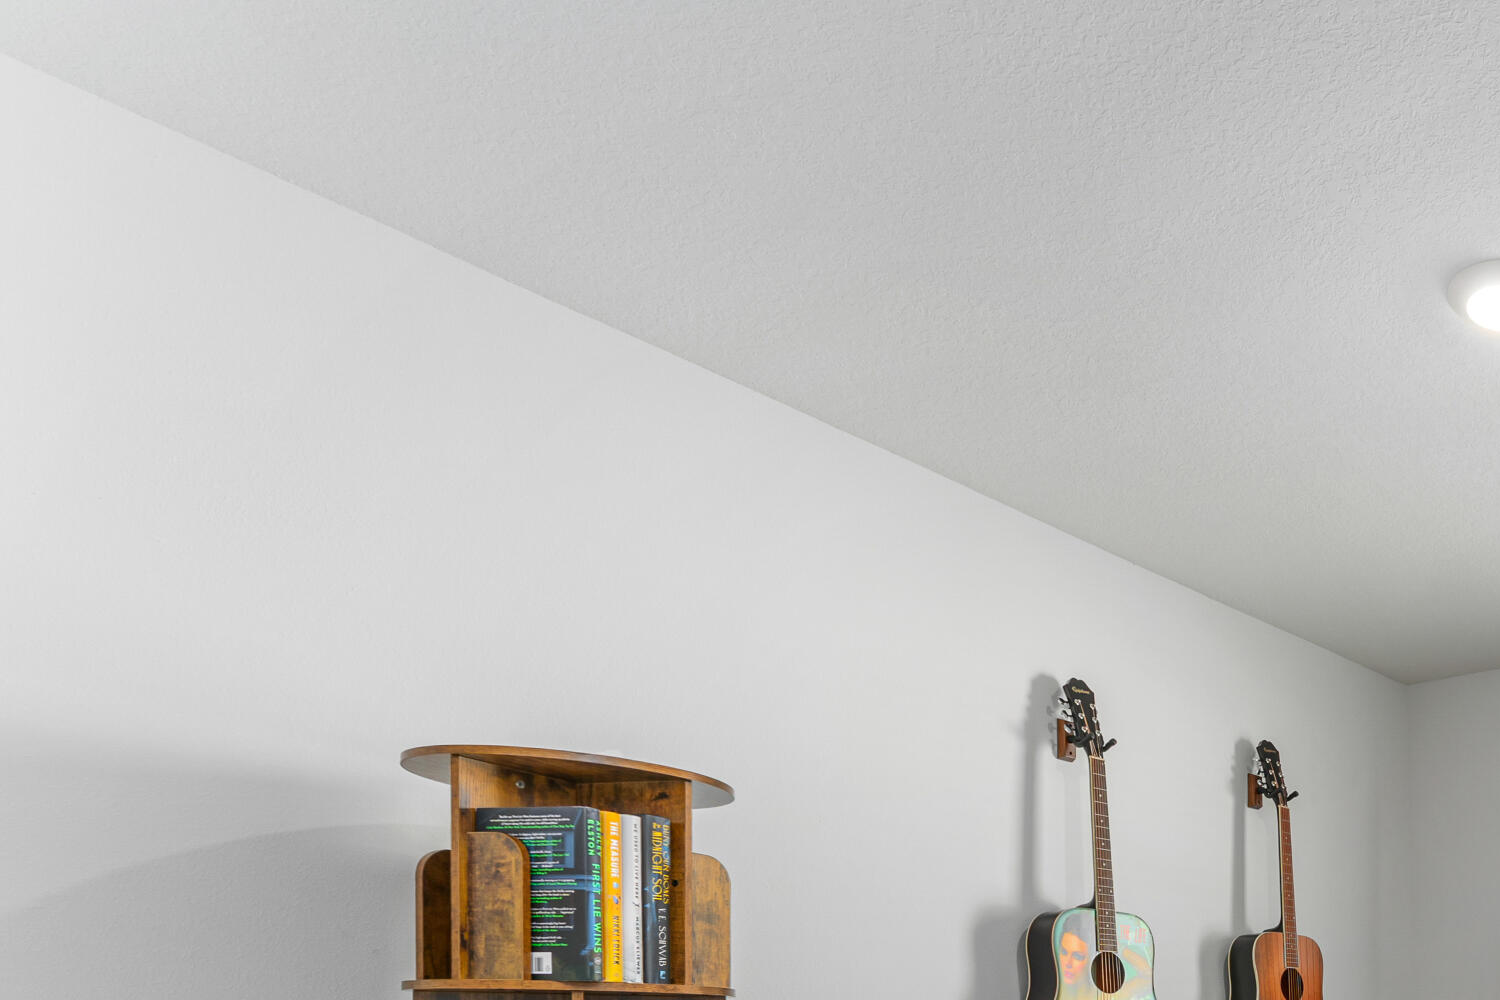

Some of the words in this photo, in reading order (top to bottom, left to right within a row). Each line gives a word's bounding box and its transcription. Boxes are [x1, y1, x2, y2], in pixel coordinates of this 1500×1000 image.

[587, 819, 595, 857] ELSTON
[609, 822, 619, 836] THE
[610, 839, 620, 878] MEASURE
[652, 831, 663, 875] MIDNIGHT
[592, 863, 601, 895] FIRST
[652, 878, 663, 902] SOIL
[593, 900, 602, 918] LIE
[594, 923, 603, 953] WINS
[658, 925, 667, 967] SCHWAB
